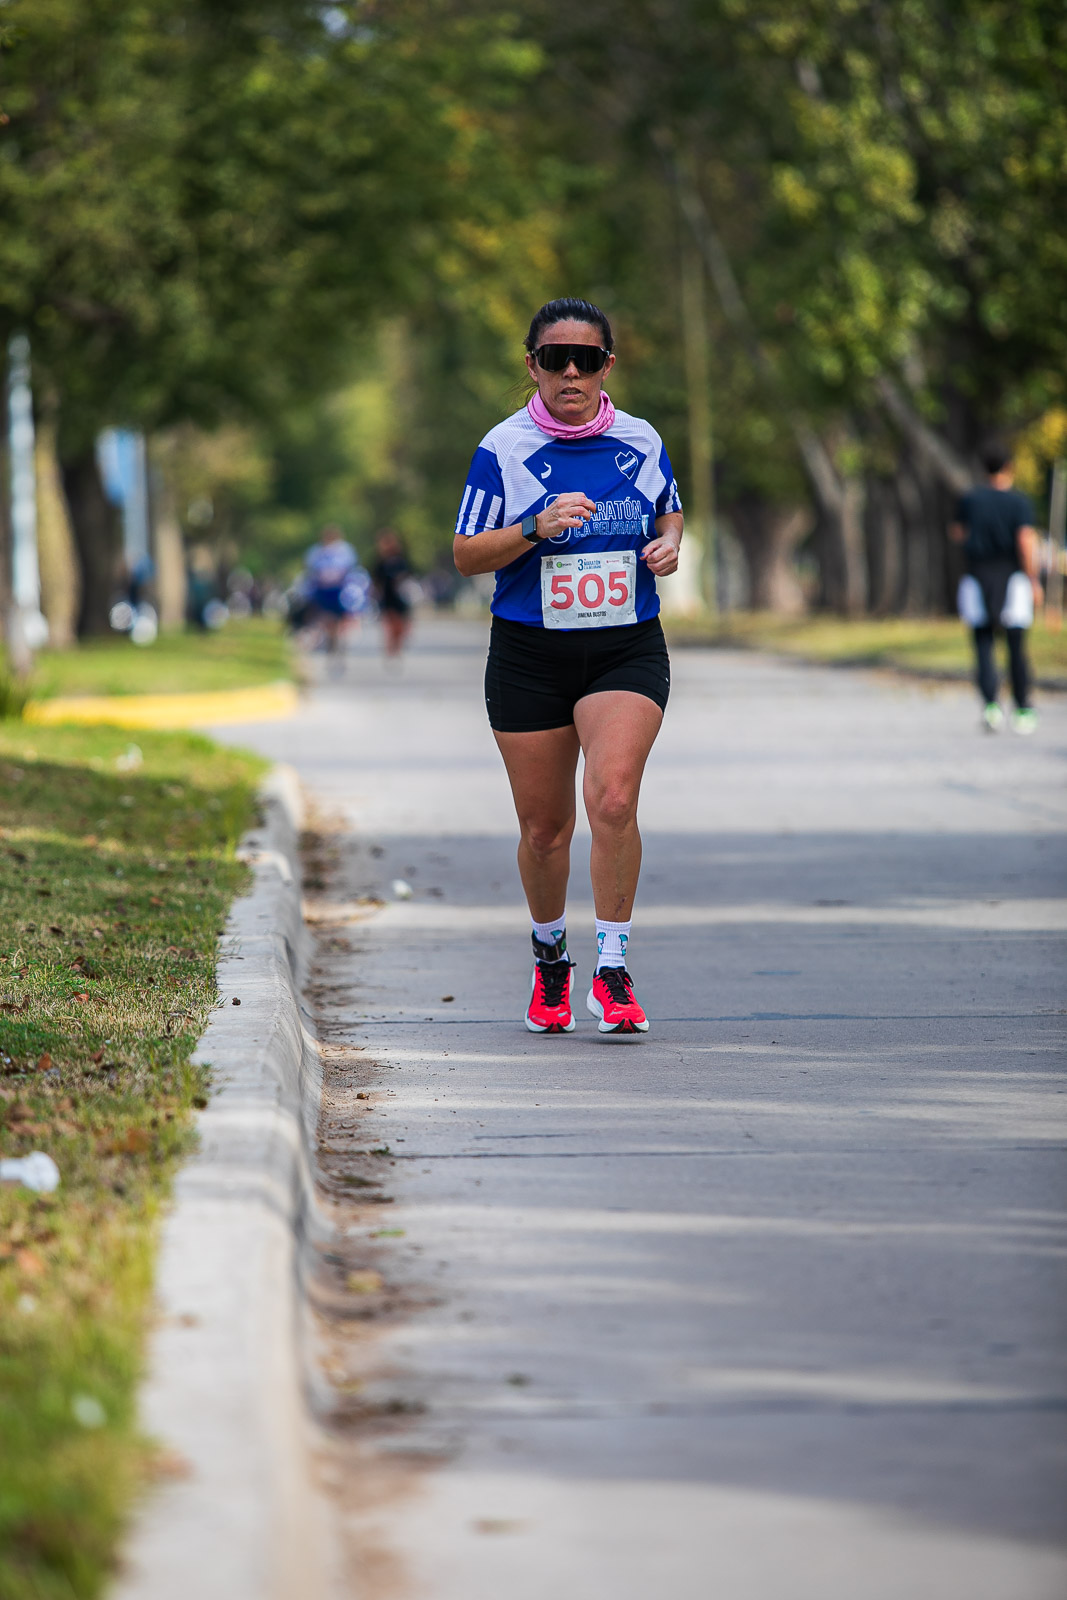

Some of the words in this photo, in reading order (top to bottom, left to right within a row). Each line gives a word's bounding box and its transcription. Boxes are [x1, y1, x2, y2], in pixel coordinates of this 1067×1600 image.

[573, 496, 642, 522] RATÓN
[550, 570, 629, 610] 505
[577, 611, 592, 619] JIMENA
